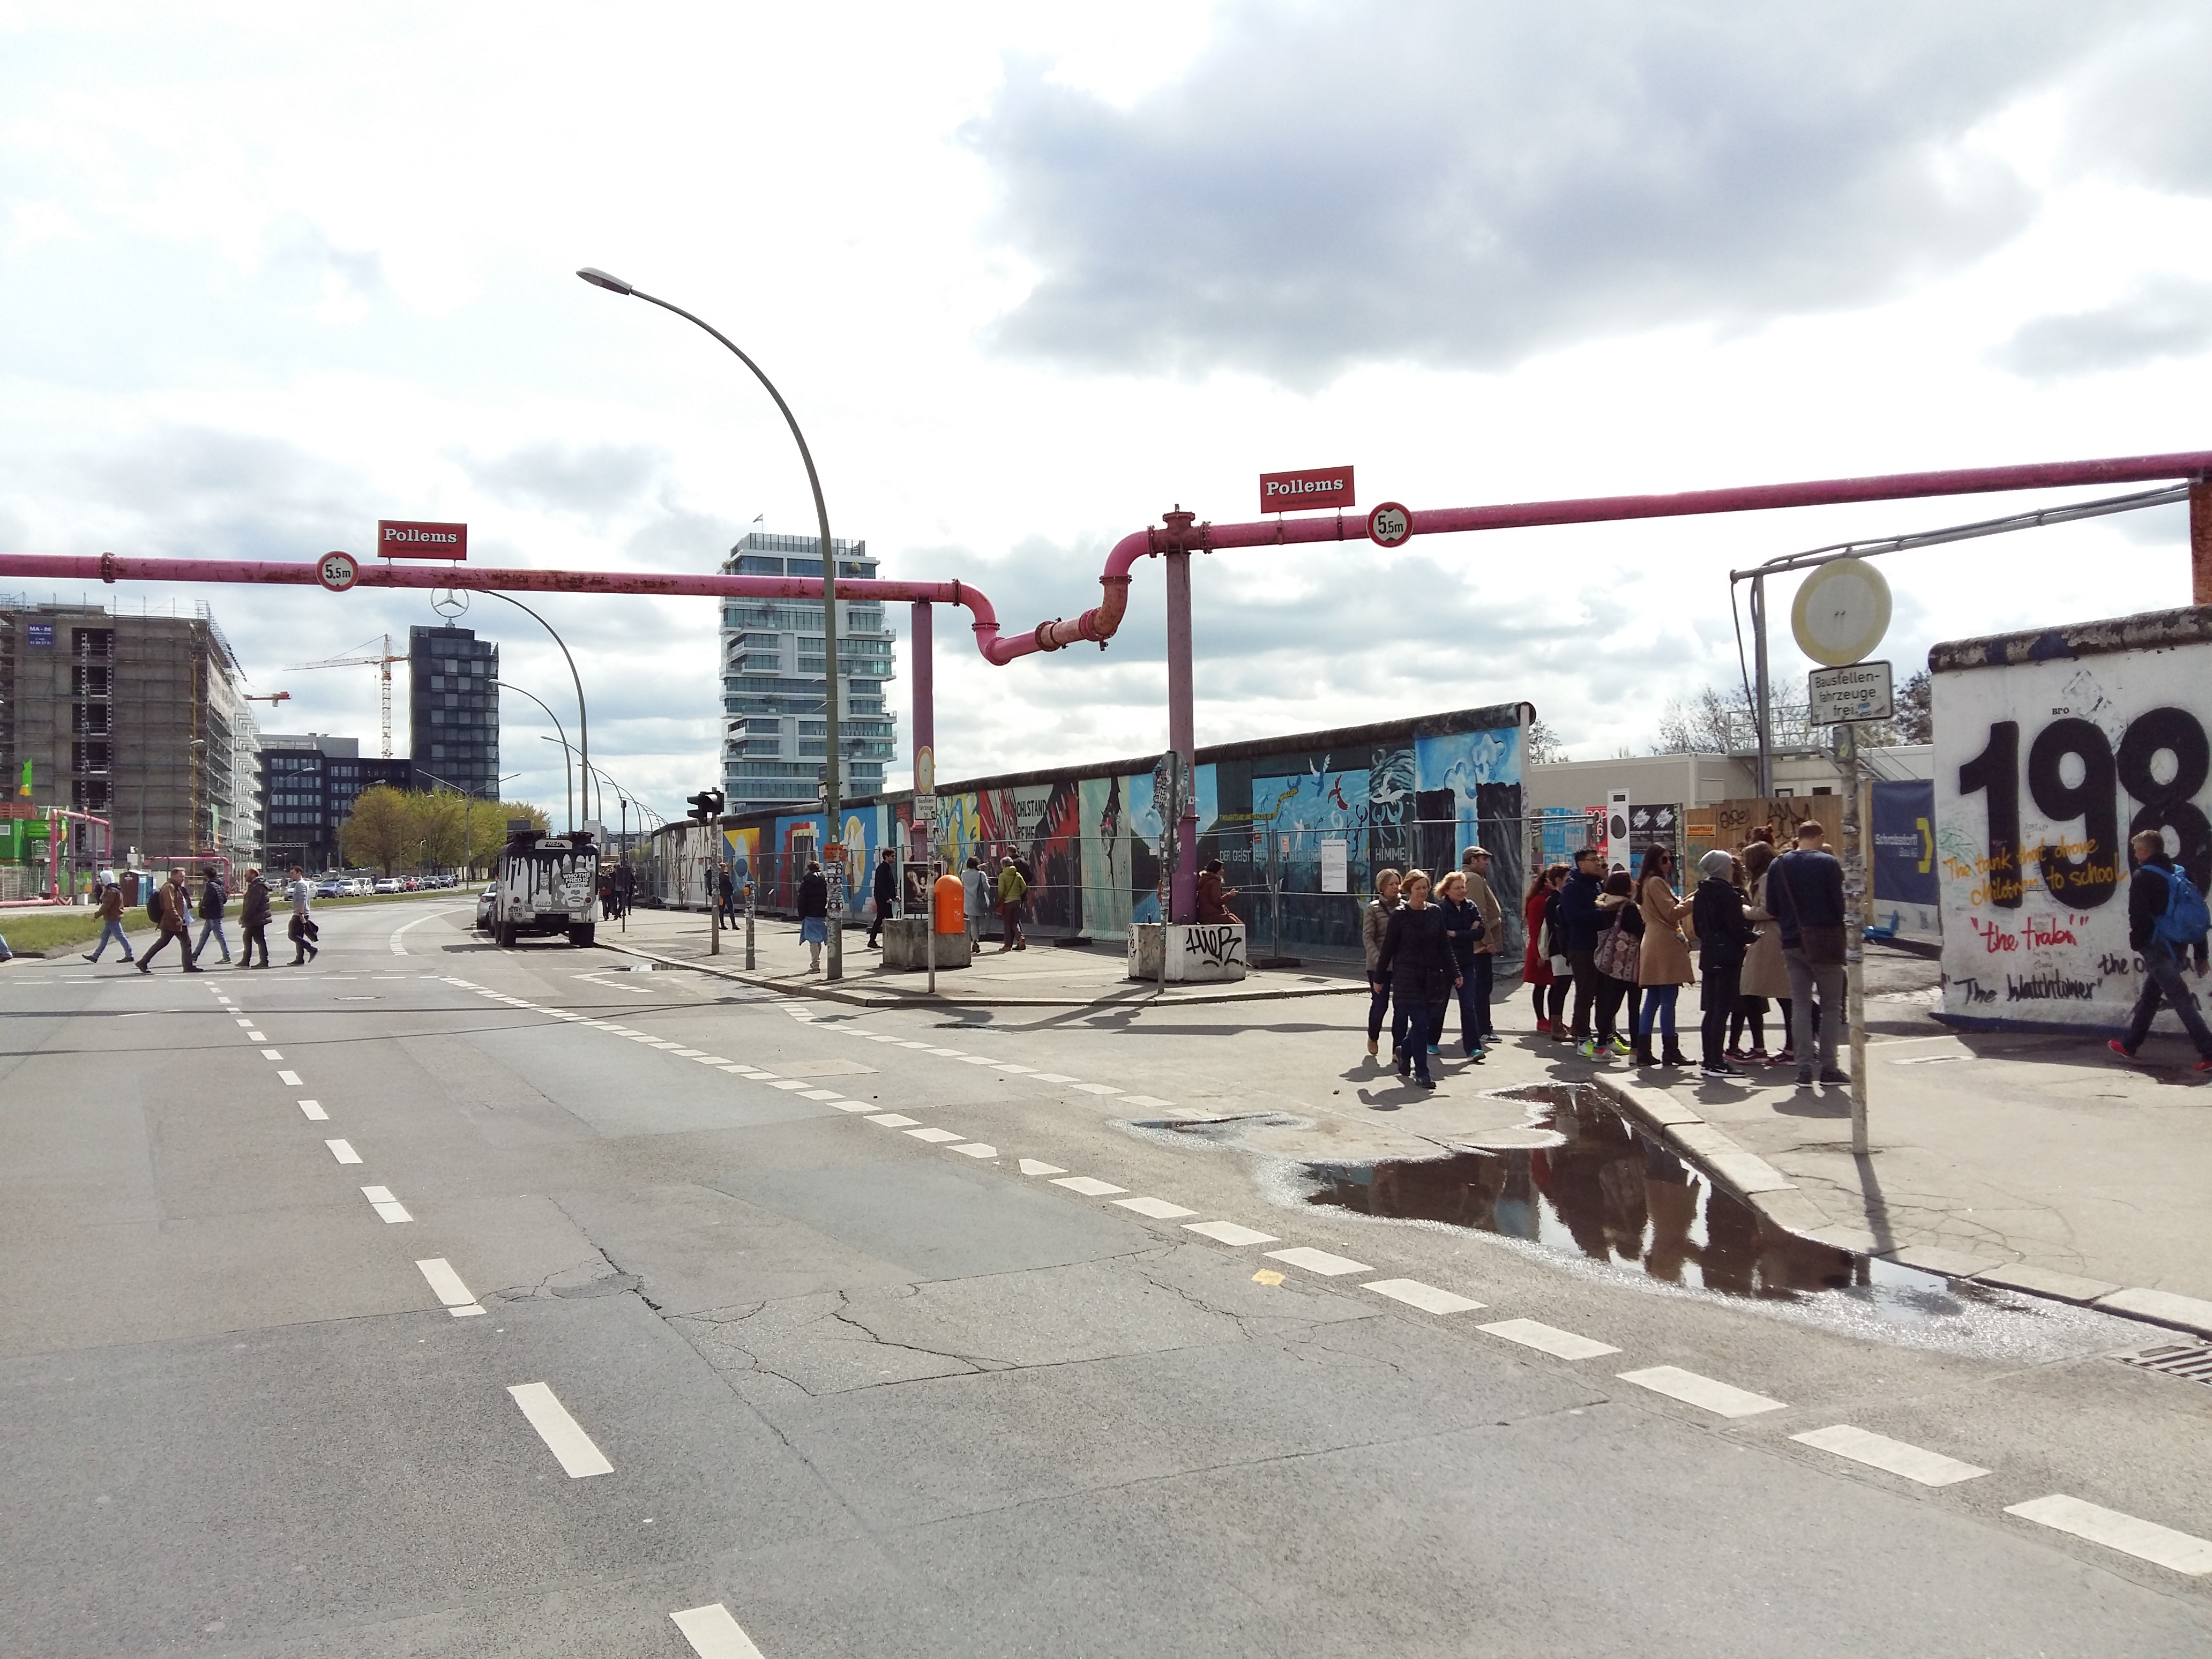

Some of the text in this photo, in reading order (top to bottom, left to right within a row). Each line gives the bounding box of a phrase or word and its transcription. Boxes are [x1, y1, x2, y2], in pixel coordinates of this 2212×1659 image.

[1266, 479, 1343, 496] Pollems
[384, 528, 457, 543] Pollems
[1815, 672, 1880, 689] Baustellen-
[1819, 688, 1876, 703] fahrzeuge
[1220, 850, 1231, 862] DER
[1233, 848, 1251, 862] GEIST
[1376, 847, 1405, 861] HIMME
[1942, 835, 2099, 880] The tank that drove
[2046, 865, 2065, 890] to
[2069, 852, 2129, 886] school
[2098, 953, 2130, 976] the
